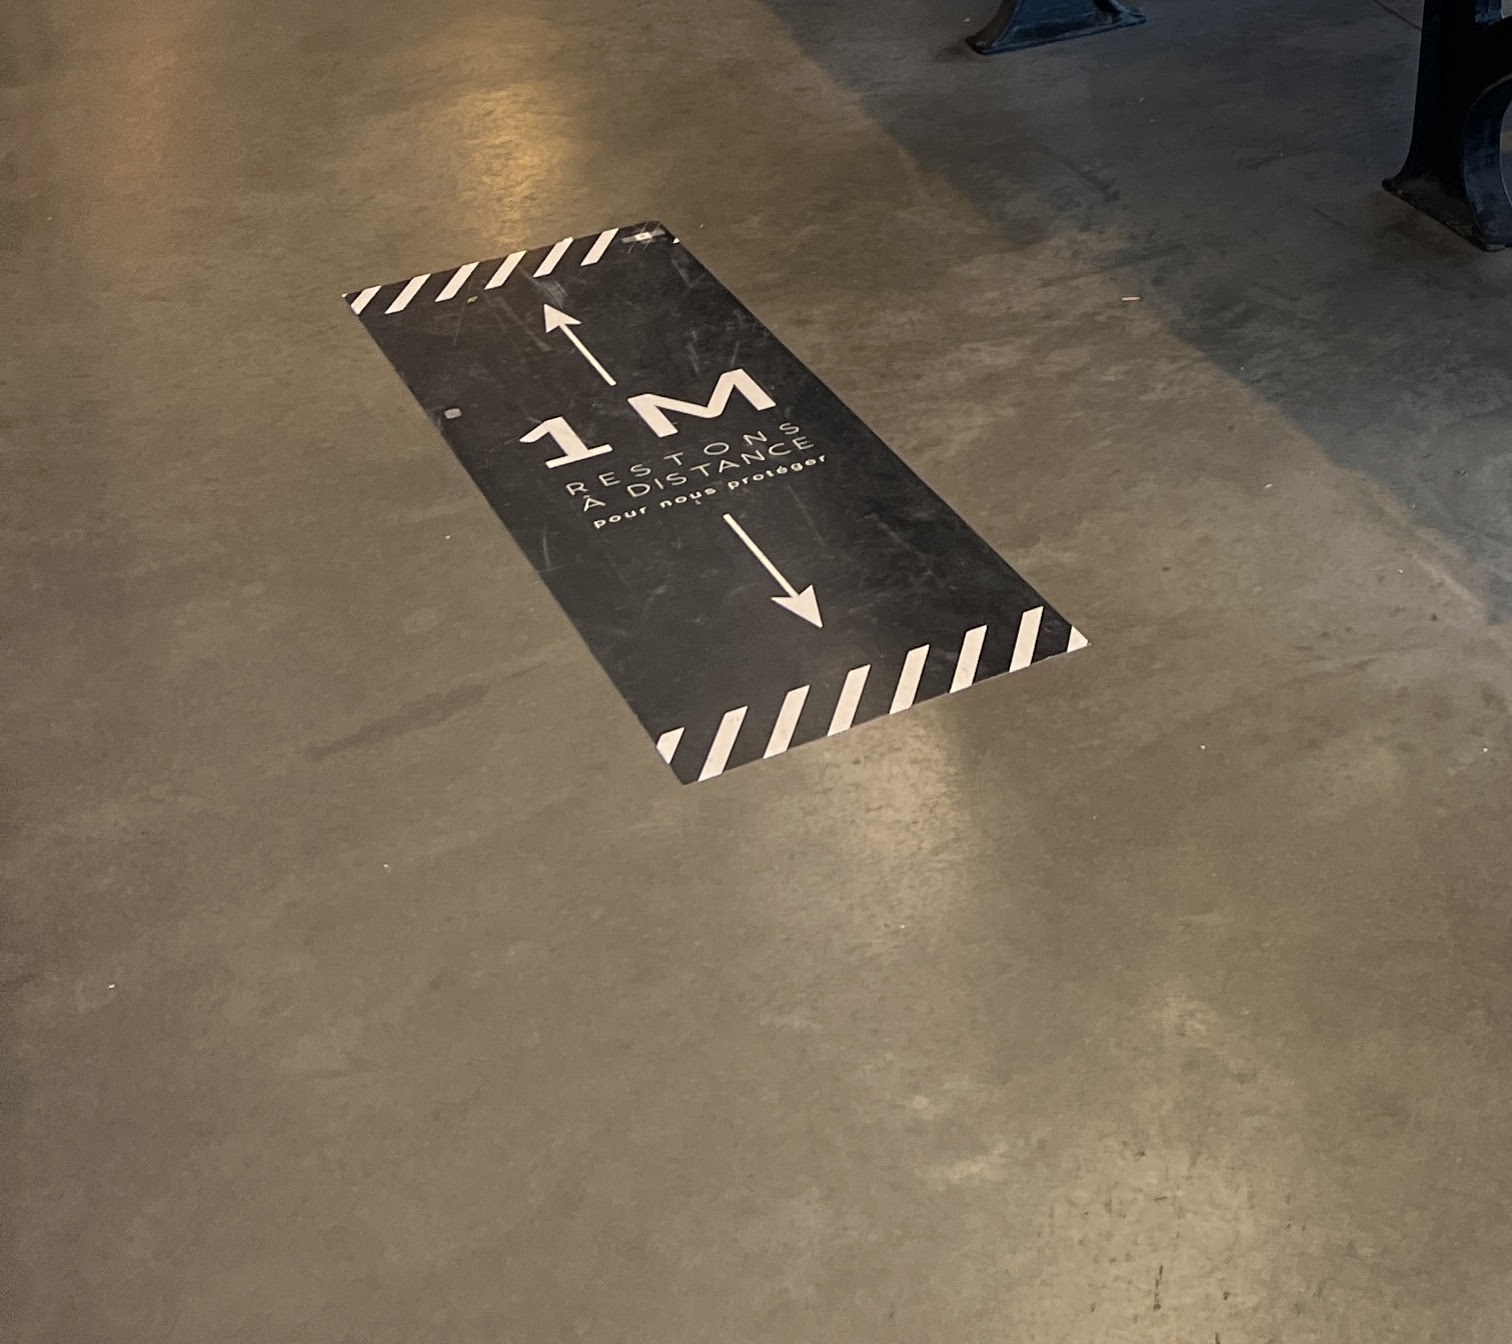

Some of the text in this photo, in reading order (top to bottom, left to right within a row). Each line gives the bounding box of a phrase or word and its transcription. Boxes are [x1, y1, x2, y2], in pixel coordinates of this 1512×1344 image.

[518, 367, 777, 469] 1 M
[565, 421, 801, 496] RESTONS
[593, 453, 828, 530] pour nous protéger
[626, 434, 815, 499] DISTANCE
